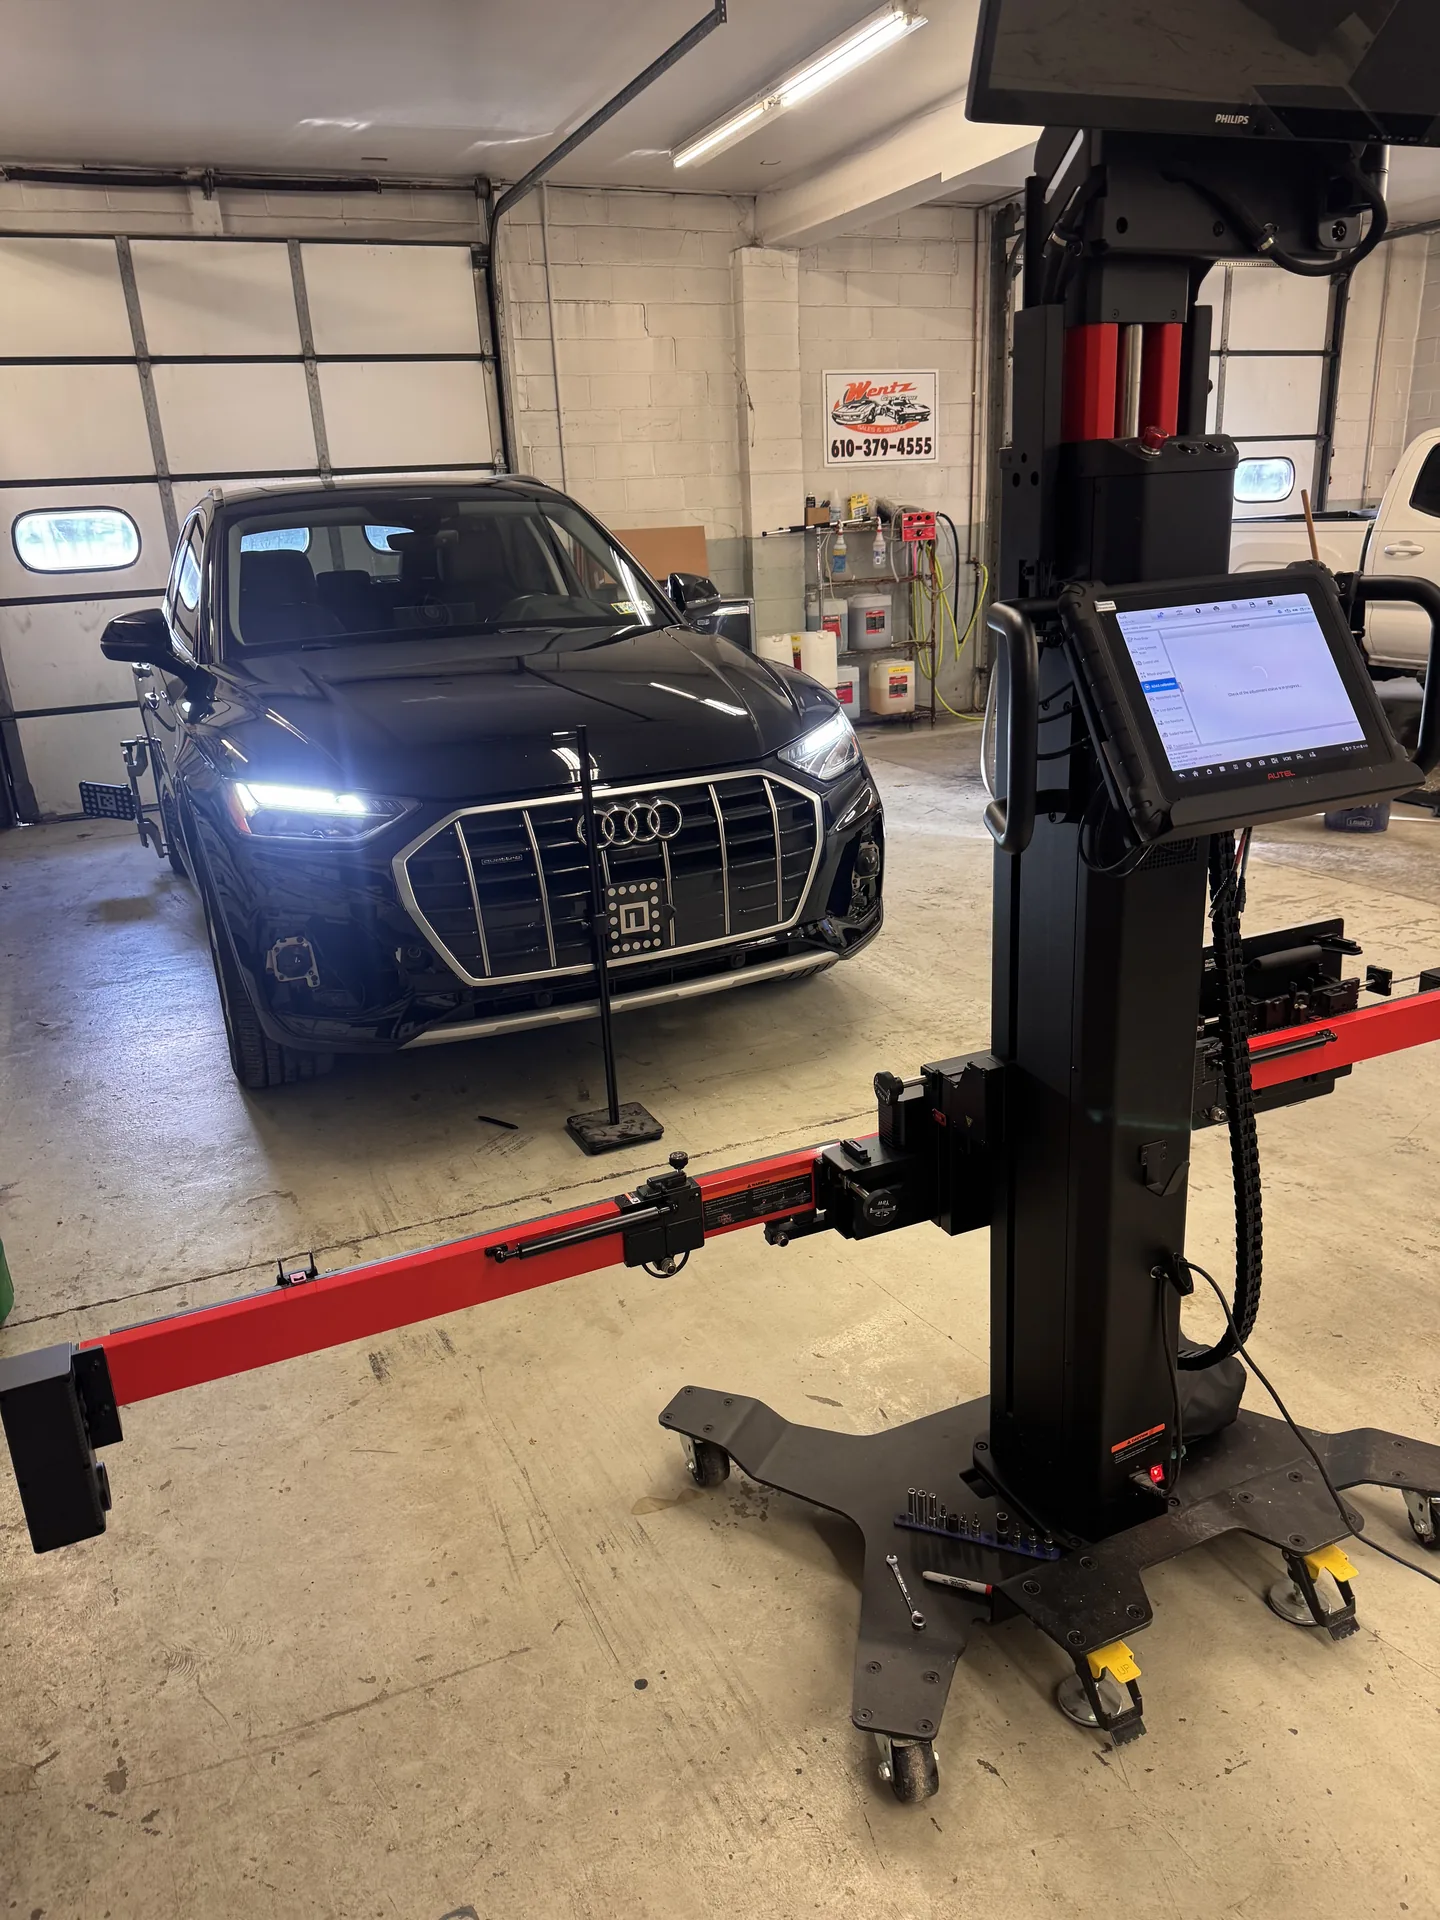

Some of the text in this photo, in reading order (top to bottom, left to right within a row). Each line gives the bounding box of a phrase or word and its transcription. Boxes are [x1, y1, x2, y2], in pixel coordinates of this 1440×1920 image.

[1215, 113, 1249, 125] PHILIPS
[845, 380, 918, 403] Wentz
[831, 437, 932, 458] 610-379-4555
[1267, 770, 1295, 780] AUTEL
[1116, 1663, 1130, 1676] UP
